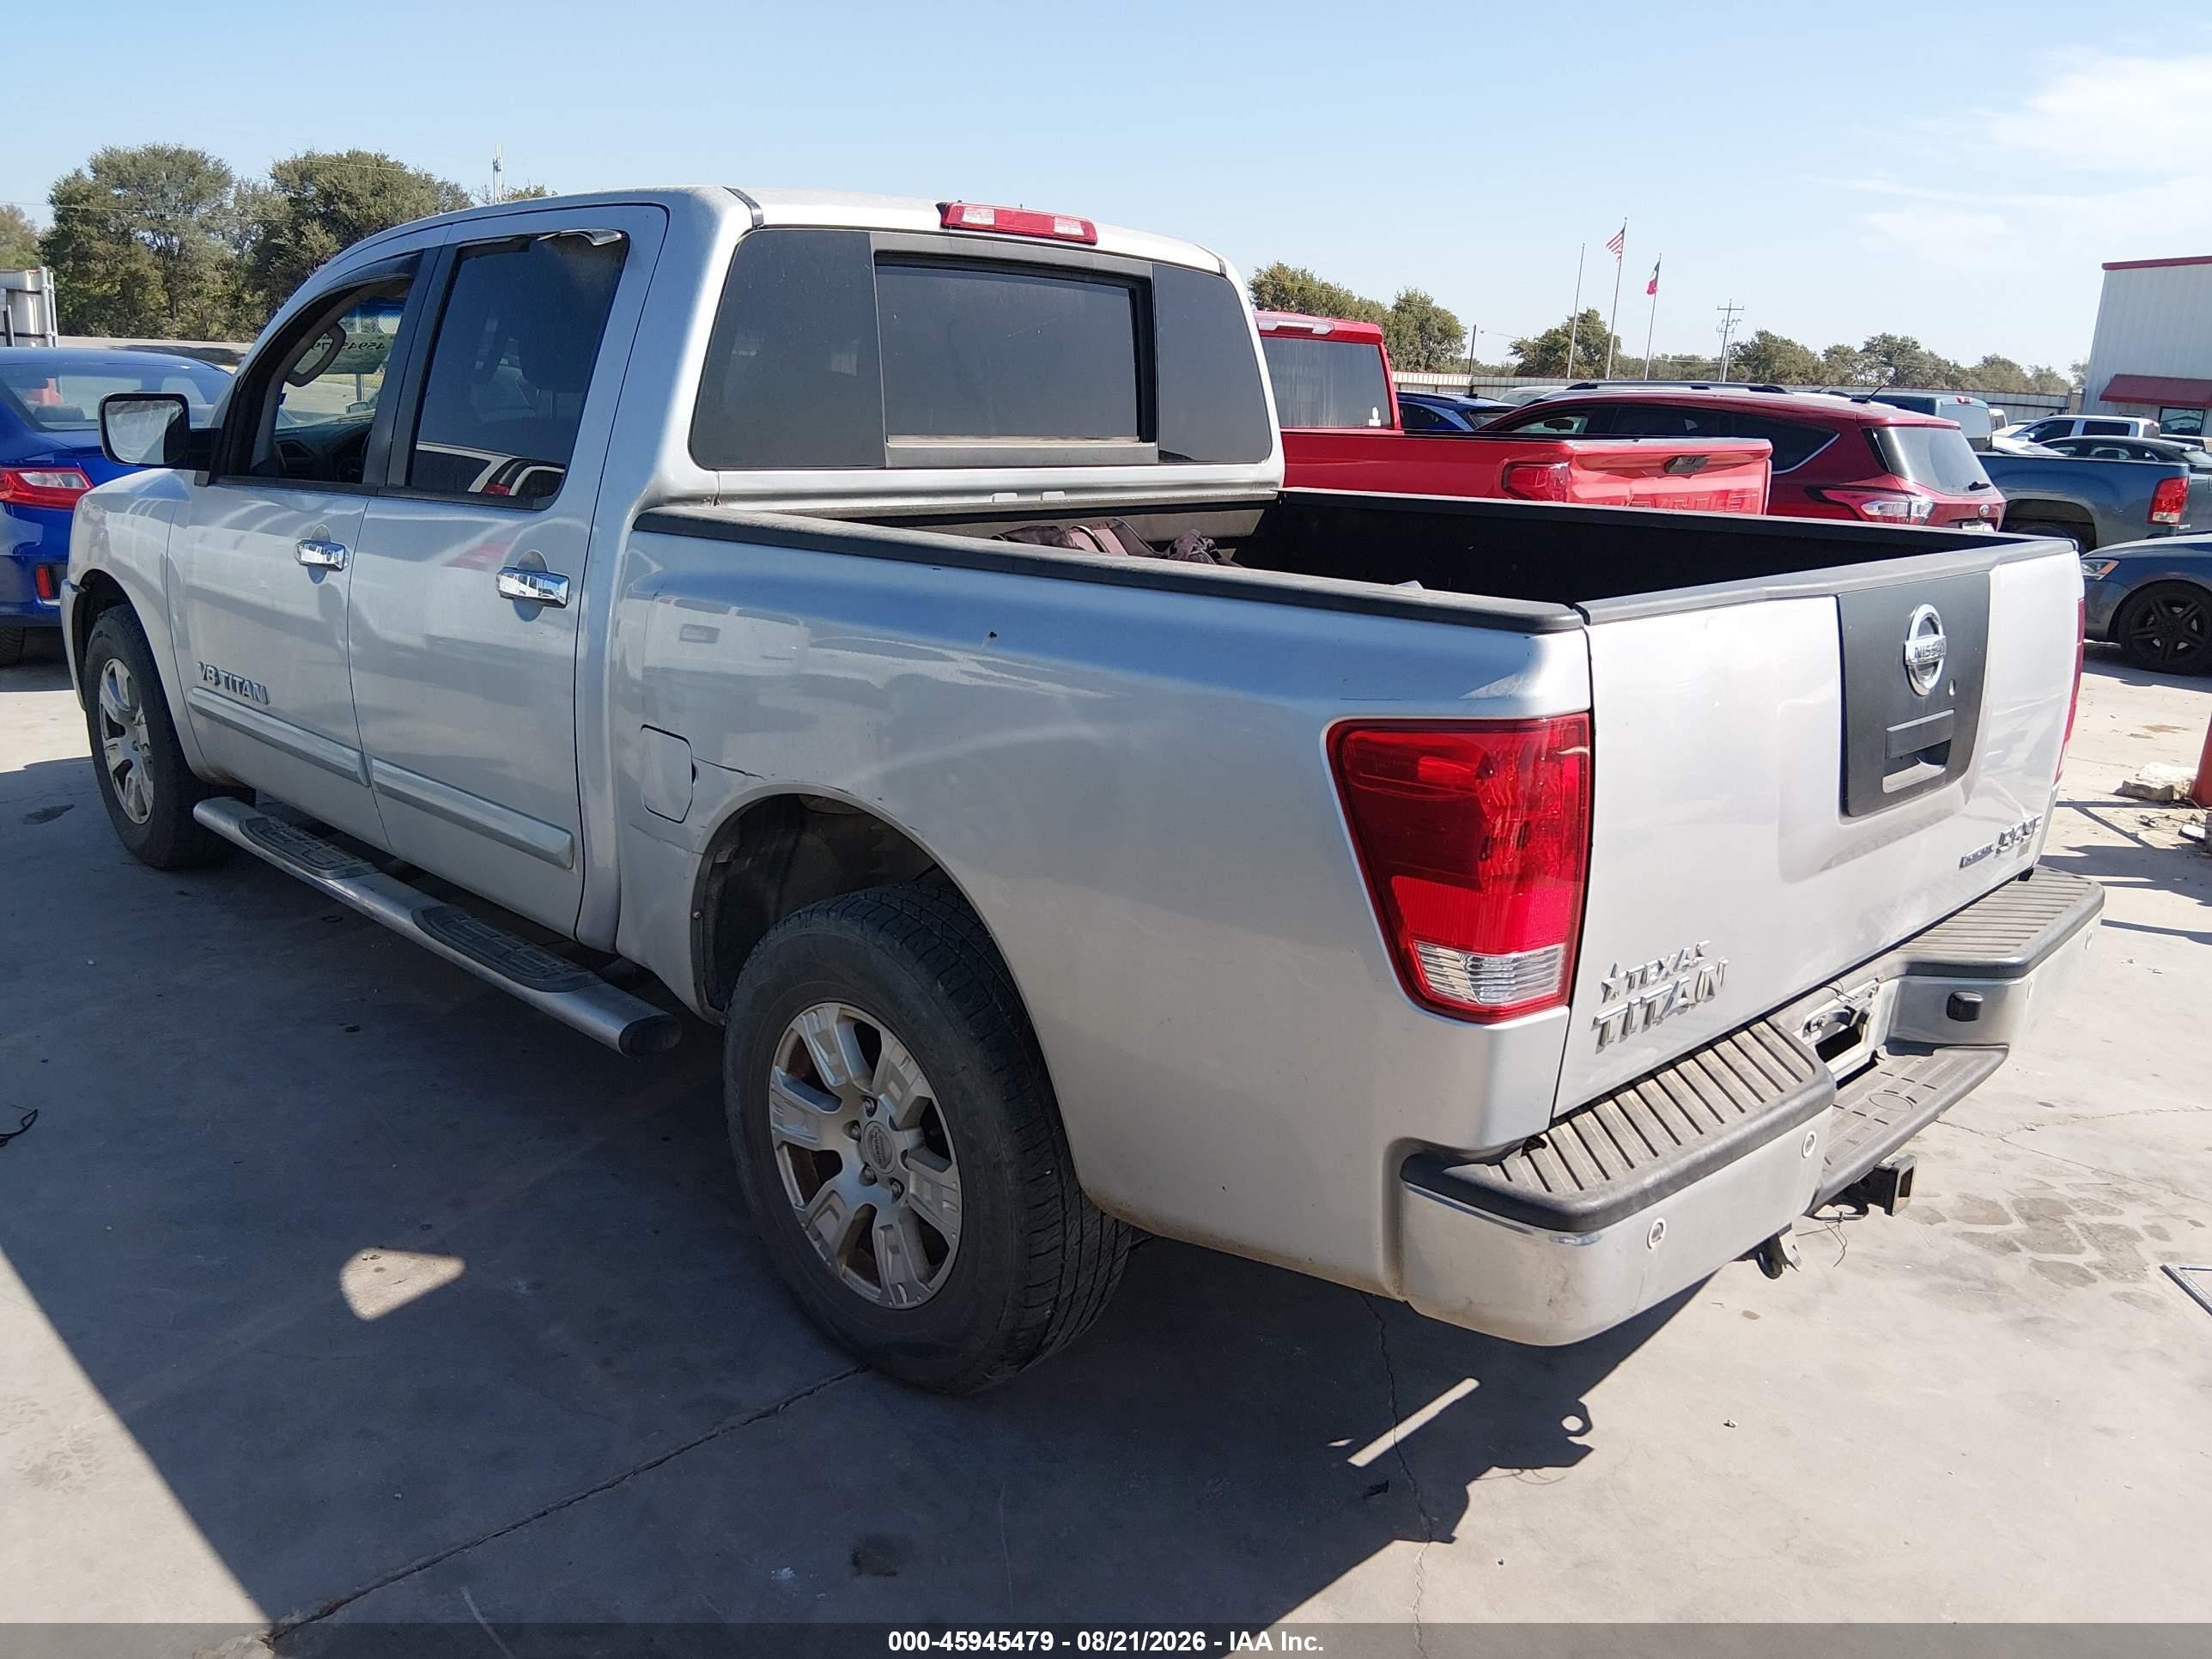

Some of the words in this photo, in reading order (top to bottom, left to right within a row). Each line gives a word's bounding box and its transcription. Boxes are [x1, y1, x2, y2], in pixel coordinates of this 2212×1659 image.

[198, 661, 220, 685] V8
[218, 670, 270, 704] TITAN
[1626, 940, 1710, 990] TEXAS
[1593, 957, 1729, 1049] TITAN
